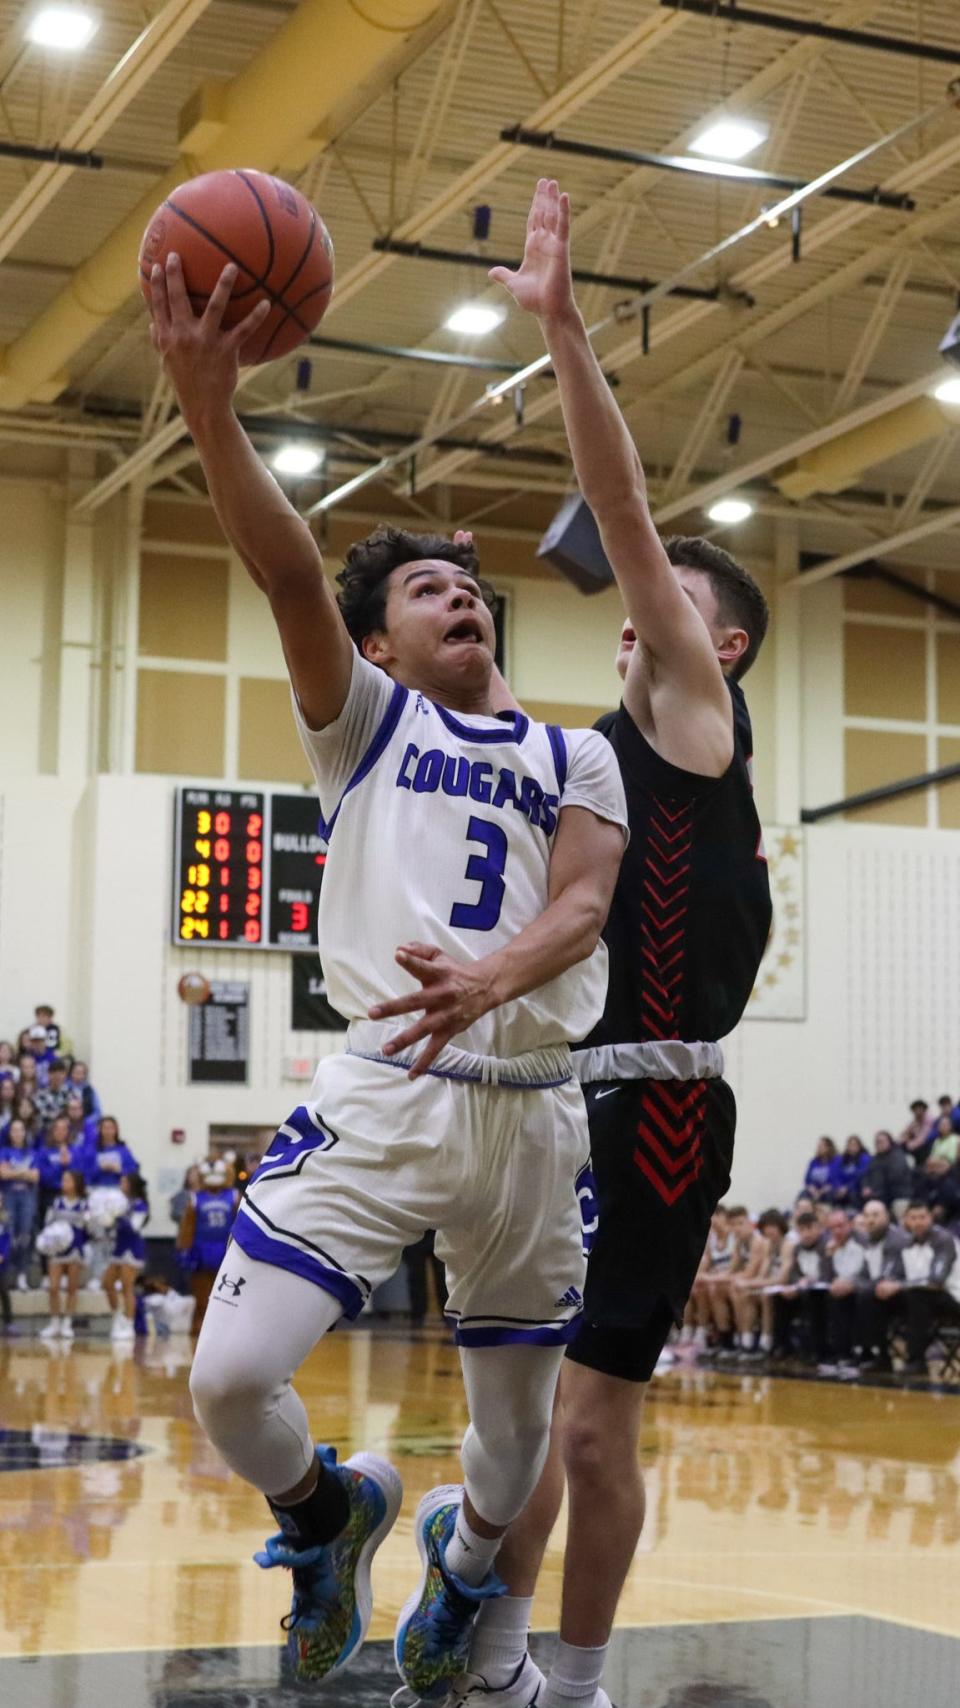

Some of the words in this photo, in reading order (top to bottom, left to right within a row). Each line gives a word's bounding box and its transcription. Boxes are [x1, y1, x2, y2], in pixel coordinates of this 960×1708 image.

[396, 743, 559, 837] COUGARS
[198, 811, 211, 834] 3
[215, 812, 230, 834] 0
[247, 814, 262, 837] 2
[195, 839, 210, 858] 4
[215, 839, 229, 861] 0
[246, 841, 261, 863] 0
[189, 864, 209, 887] 13
[221, 867, 229, 886] 1
[248, 867, 261, 889] 3
[450, 815, 508, 931] 3
[181, 890, 209, 913] 22
[220, 894, 228, 912] 1
[246, 893, 260, 915] 2
[291, 902, 308, 931] 3
[181, 917, 208, 939] 24
[220, 920, 228, 938] 1
[245, 920, 259, 942] 0
